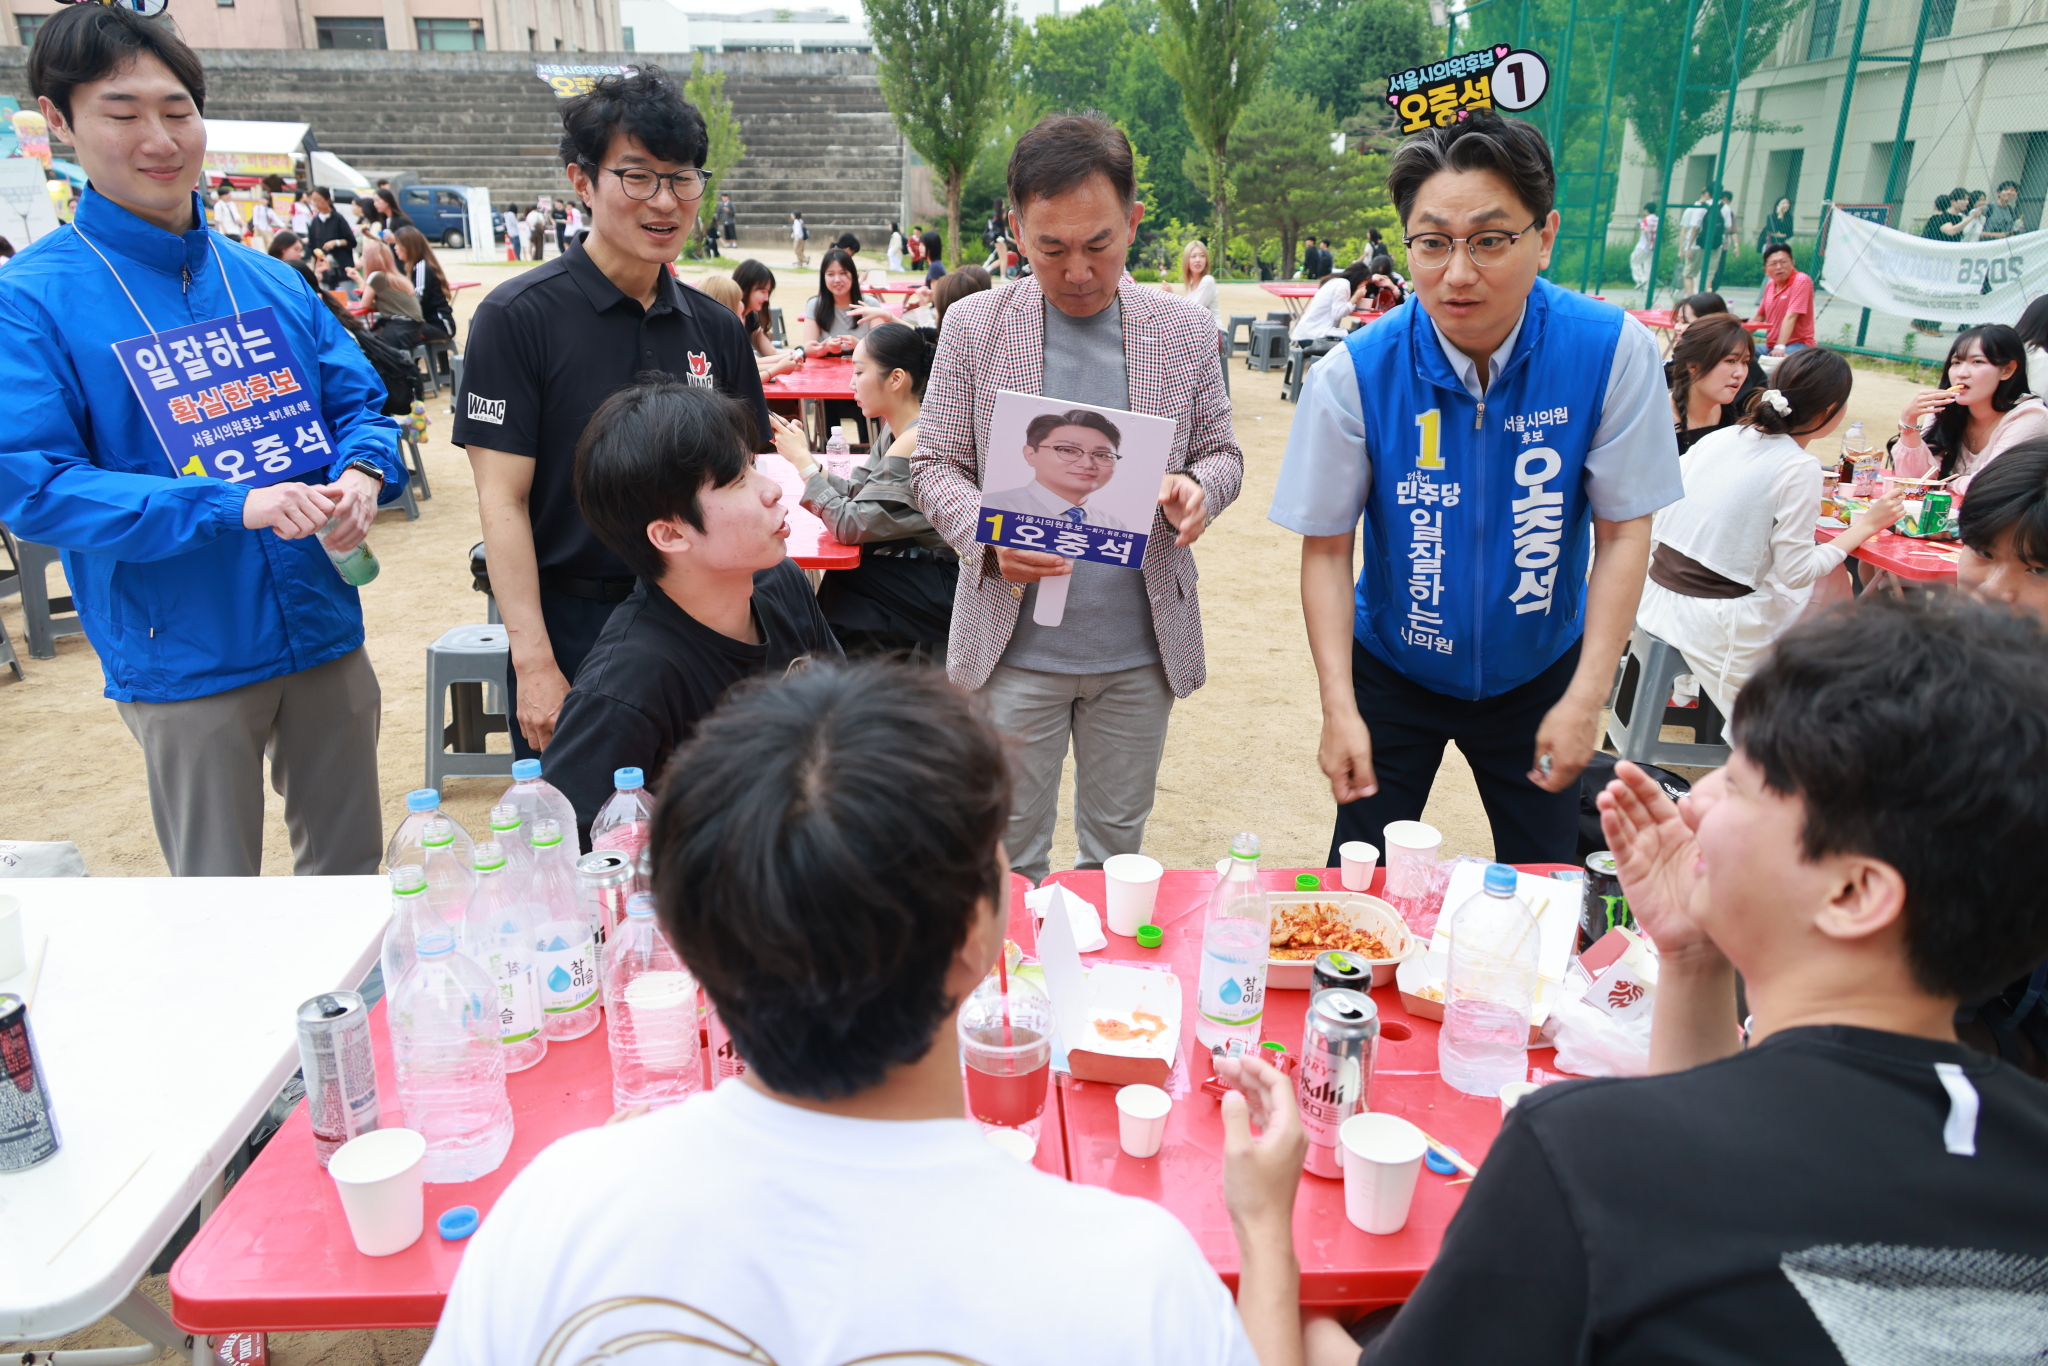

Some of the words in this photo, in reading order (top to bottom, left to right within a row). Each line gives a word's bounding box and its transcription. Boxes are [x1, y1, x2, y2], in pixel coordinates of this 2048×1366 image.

[1389, 49, 1495, 93] 서울시의원후보
[1507, 62, 1526, 103] 1
[551, 77, 605, 97] 오중
[1400, 75, 1492, 133] 오중석
[135, 323, 277, 391] 일잘하는
[167, 367, 302, 425] 확실한후보
[469, 393, 505, 420] WAAC
[191, 414, 265, 448] 서울시의원후보
[1503, 406, 1569, 432] 서울시의원
[214, 420, 332, 483] 오중석
[1415, 408, 1446, 470] 1
[1521, 430, 1545, 445] 후보
[1406, 470, 1430, 485] 더불어
[1396, 481, 1461, 507] 민주당
[985, 513, 1004, 541] 1
[1015, 514, 1084, 532] 서울시의원후보
[1507, 446, 1564, 617] 오중석
[1009, 524, 1133, 565] 오중석
[1407, 508, 1446, 635] 일잘하는
[1401, 626, 1453, 655] 시의원
[575, 987, 593, 1002] fresh
[1241, 1006, 1259, 1017] fresh
[1304, 1056, 1331, 1077] DRY
